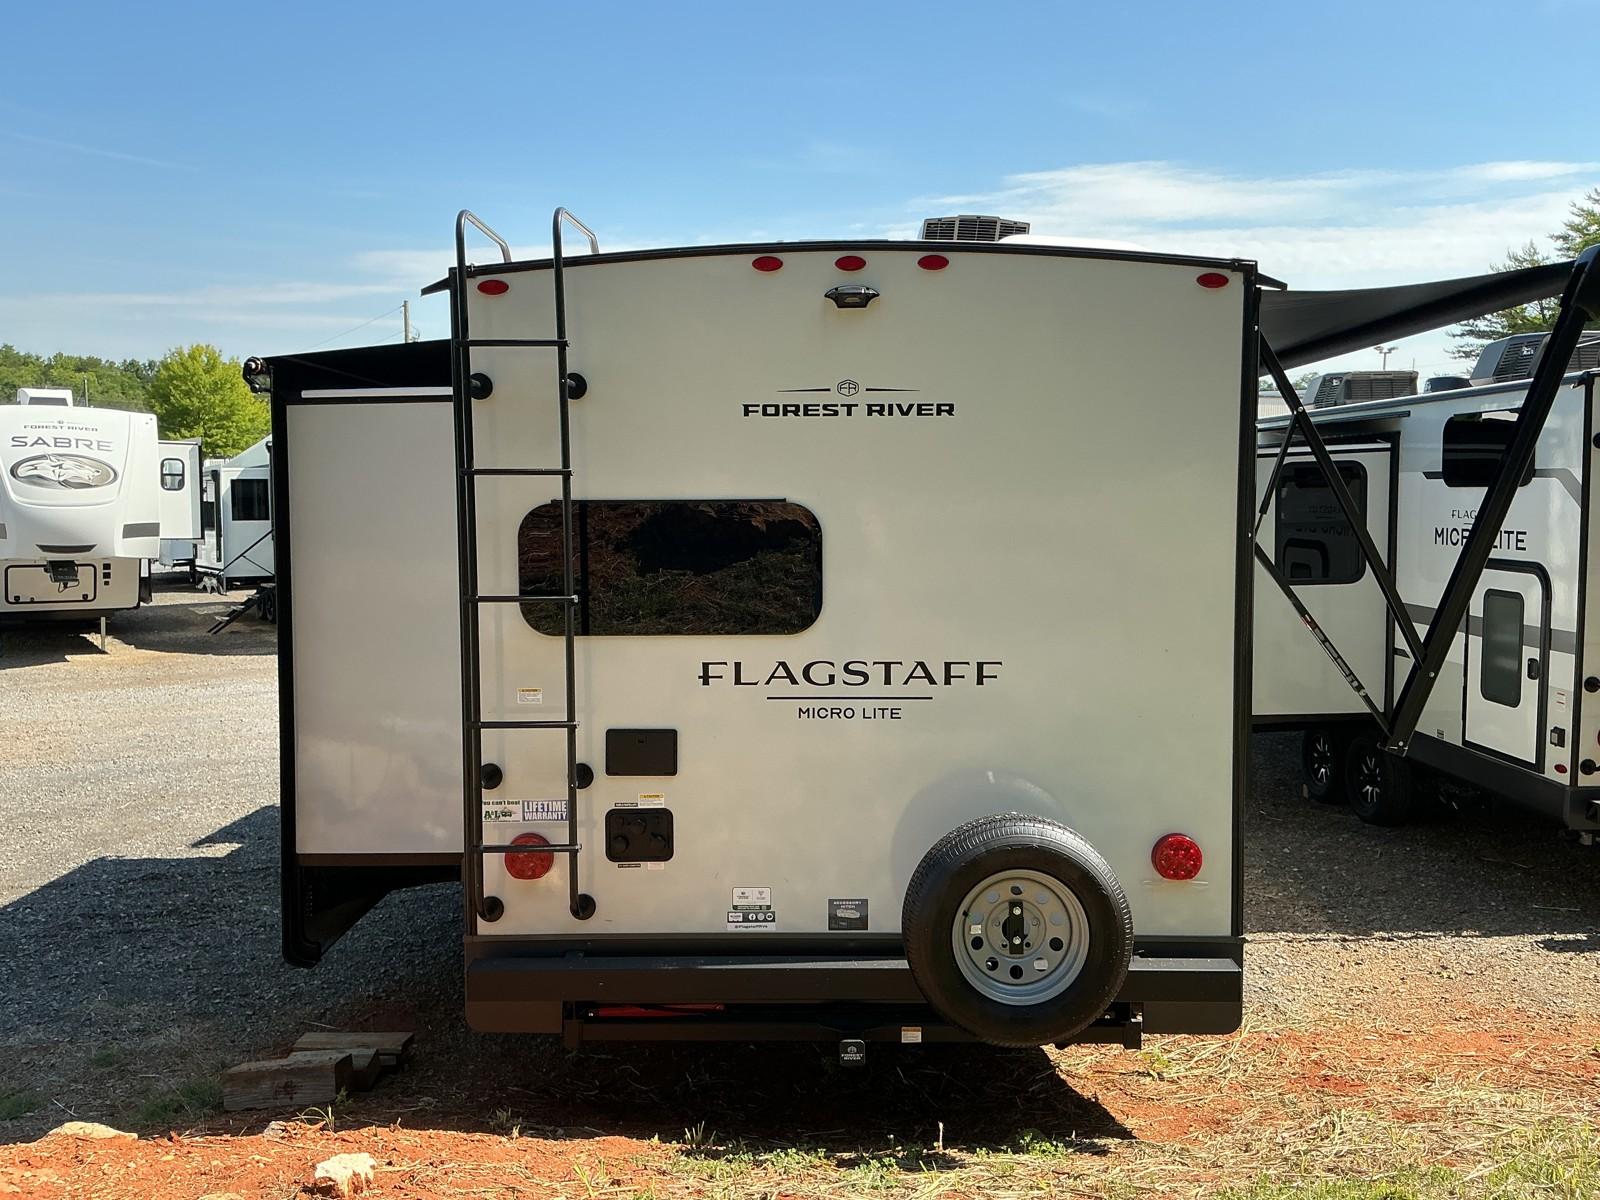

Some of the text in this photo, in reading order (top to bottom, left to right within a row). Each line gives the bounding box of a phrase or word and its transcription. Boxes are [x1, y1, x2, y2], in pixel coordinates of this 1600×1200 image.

[741, 403, 955, 417] FOREST RIVER
[11, 436, 113, 452] SABRE
[1434, 527, 1527, 551] MICR ITE
[698, 660, 1003, 687] FLAGSTAFF
[798, 707, 903, 720] MICRO LITE
[524, 801, 567, 812] LIFETIME
[524, 811, 567, 820] WARRANTY
